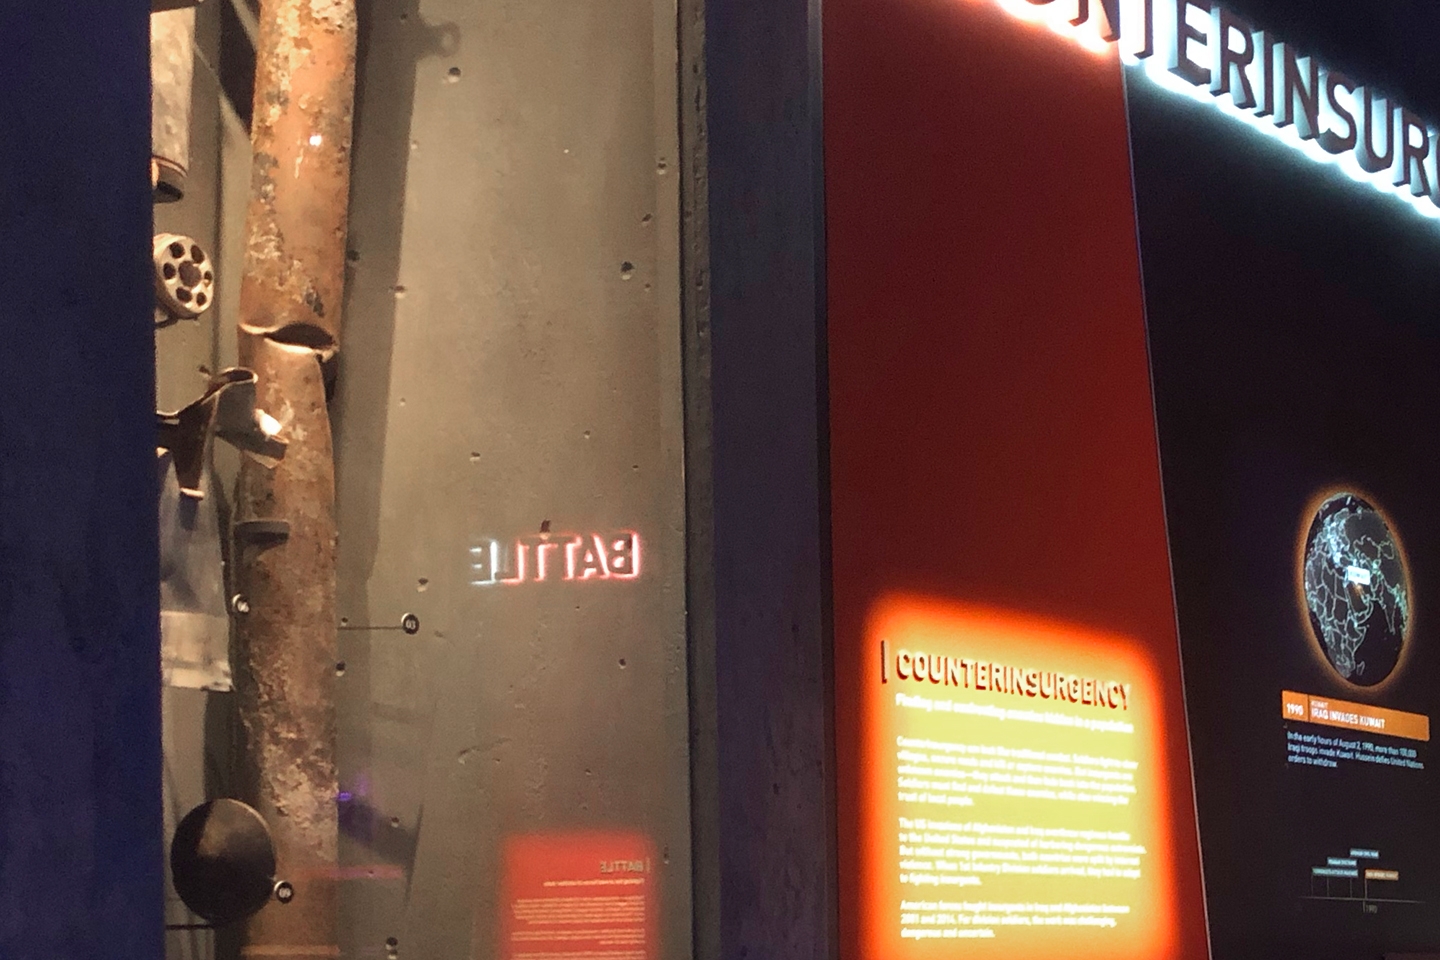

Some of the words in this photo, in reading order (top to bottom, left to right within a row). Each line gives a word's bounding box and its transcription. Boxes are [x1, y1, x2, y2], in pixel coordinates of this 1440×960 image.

[895, 648, 1132, 711] COUNTERINSURGENCY
[1330, 710, 1359, 725] INVADES
[1360, 715, 1385, 729] KUWAIT
